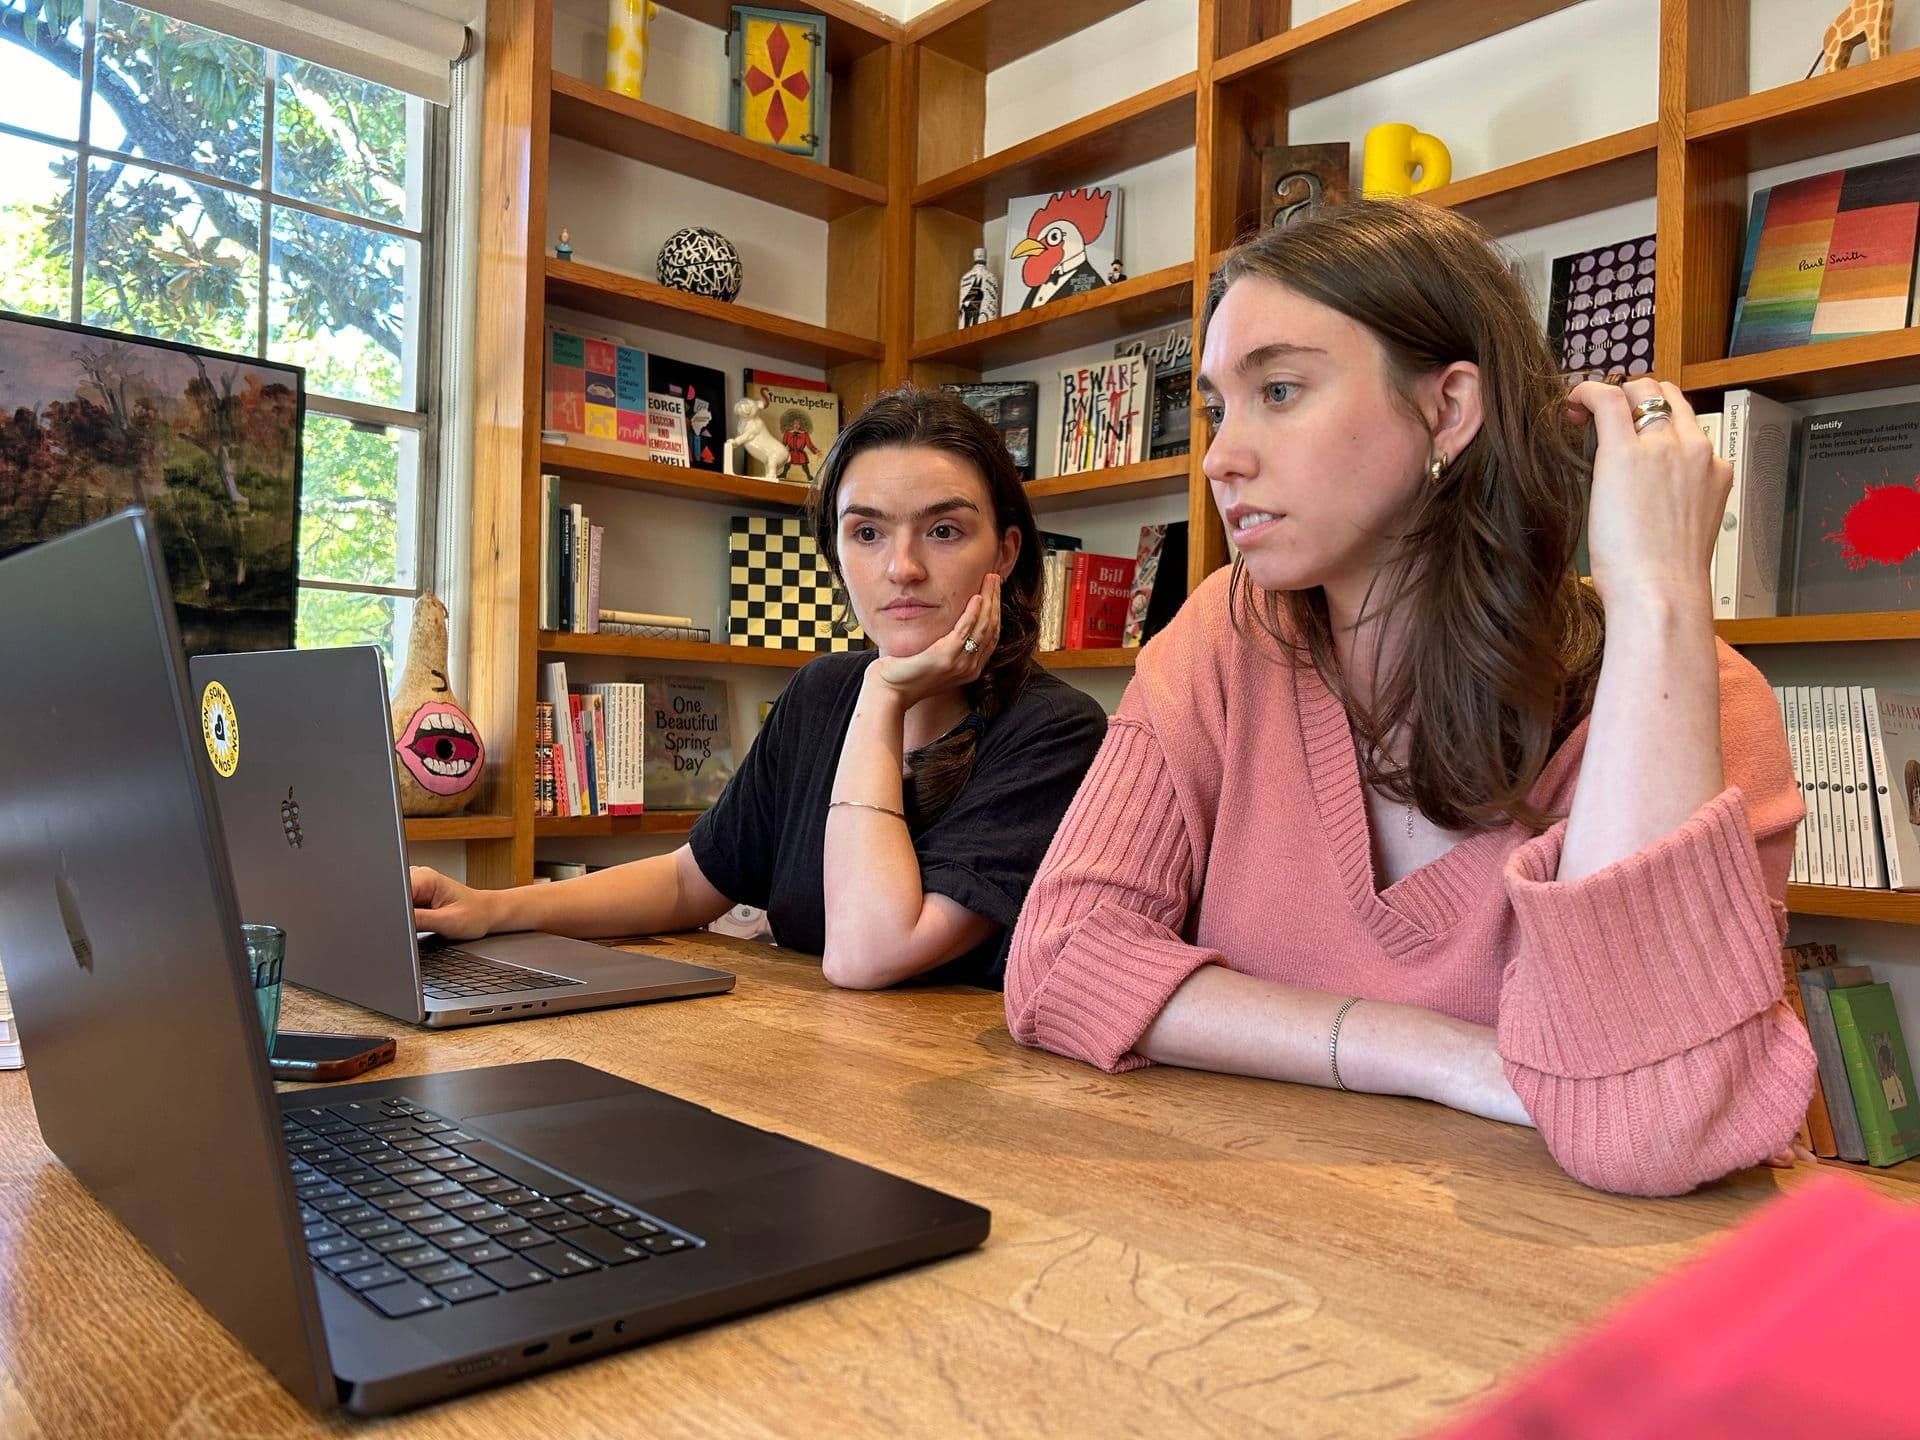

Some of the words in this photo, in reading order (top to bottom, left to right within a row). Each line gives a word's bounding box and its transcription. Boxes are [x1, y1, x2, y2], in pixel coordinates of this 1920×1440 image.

[1799, 257, 1825, 272] Paul
[1829, 252, 1868, 265] Smith
[1571, 315, 1586, 331] in
[1567, 345, 1586, 358] paul
[1588, 339, 1612, 351] smith
[1064, 359, 1139, 396] BEWARE
[648, 397, 682, 415] EORGE
[760, 387, 835, 410] Struwwelpeter
[1730, 404, 1739, 431] Daniel
[1810, 420, 1842, 431] Identify
[657, 427, 670, 439] AND
[1066, 411, 1139, 444] PAINT
[1810, 431, 1831, 441] Basic
[1832, 426, 1873, 439] principles
[1875, 423, 1884, 433] of
[1884, 420, 1919, 432] identity
[1728, 431, 1738, 458] Eatock
[1809, 441, 1818, 450] in
[1818, 439, 1832, 449] the
[1833, 437, 1859, 448] iconic
[1860, 432, 1908, 445] trademarks
[649, 454, 686, 468] RWELL
[1809, 452, 1818, 460] of
[1099, 567, 1123, 583] Bill
[1089, 581, 1131, 600] Bryson
[673, 696, 702, 714] One
[656, 710, 718, 731] Beautiful
[665, 732, 712, 758] Spring
[674, 755, 705, 776] Day
[598, 782, 607, 801] DAY
